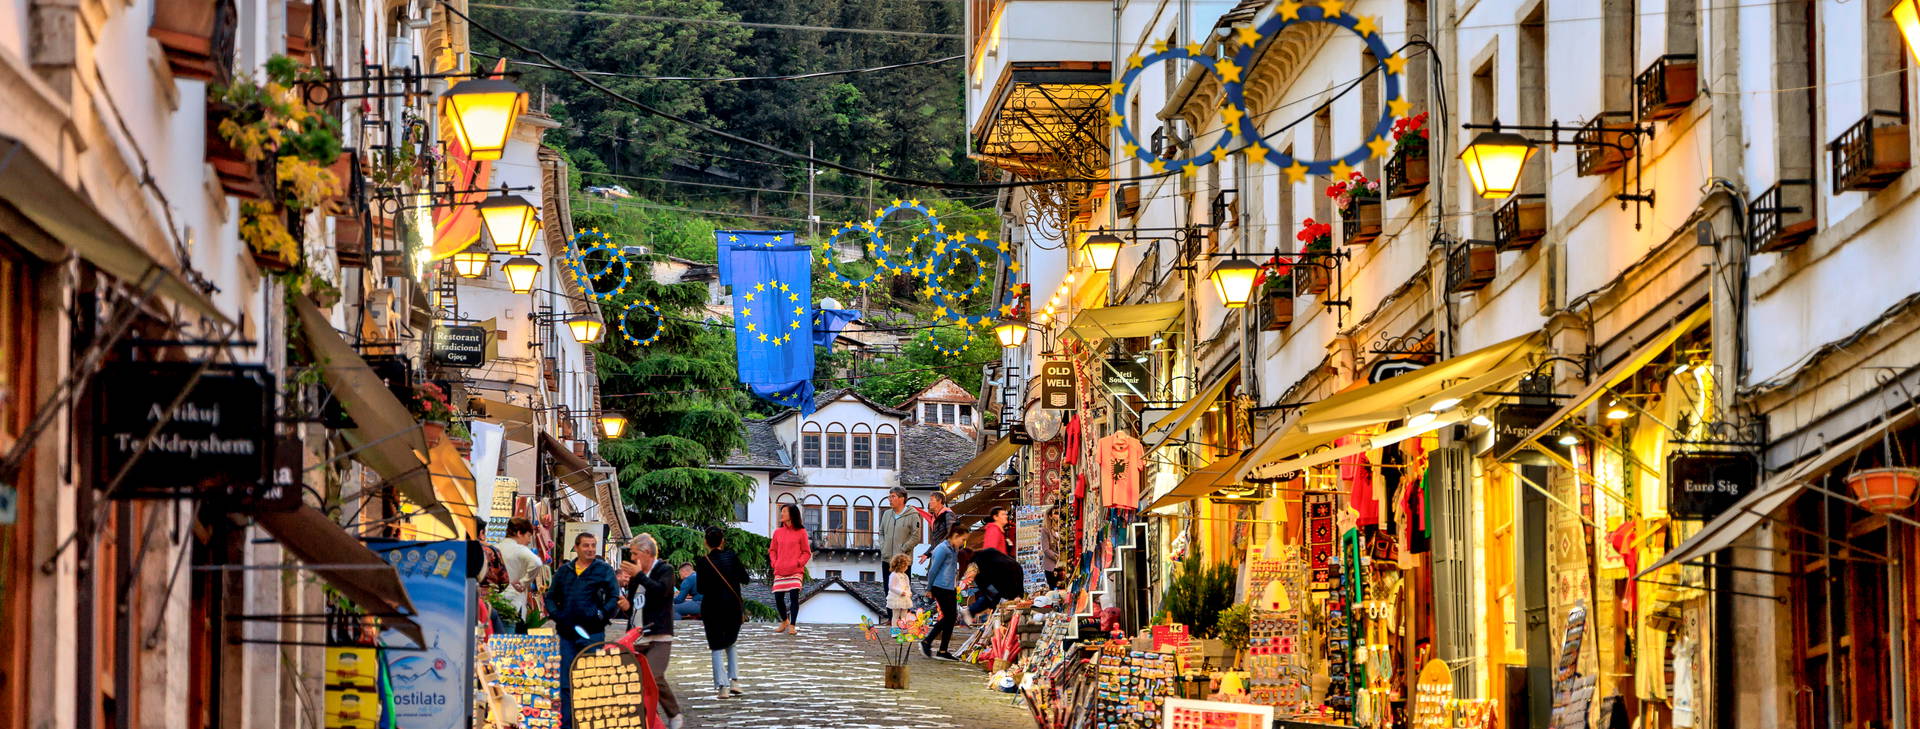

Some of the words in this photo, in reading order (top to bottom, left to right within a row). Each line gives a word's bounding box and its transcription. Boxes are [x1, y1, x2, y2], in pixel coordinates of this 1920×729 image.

[437, 332, 480, 342] Restorant
[435, 343, 481, 352] Tradicional
[447, 352, 467, 361] Gjoça
[1047, 367, 1071, 376] OLD
[1046, 378, 1072, 388] WELL
[147, 402, 221, 427] Atikuj
[1503, 424, 1561, 438] Argjeari
[149, 432, 256, 460] Ndryshem
[1684, 479, 1715, 493] Euro
[1717, 479, 1739, 495] Sig
